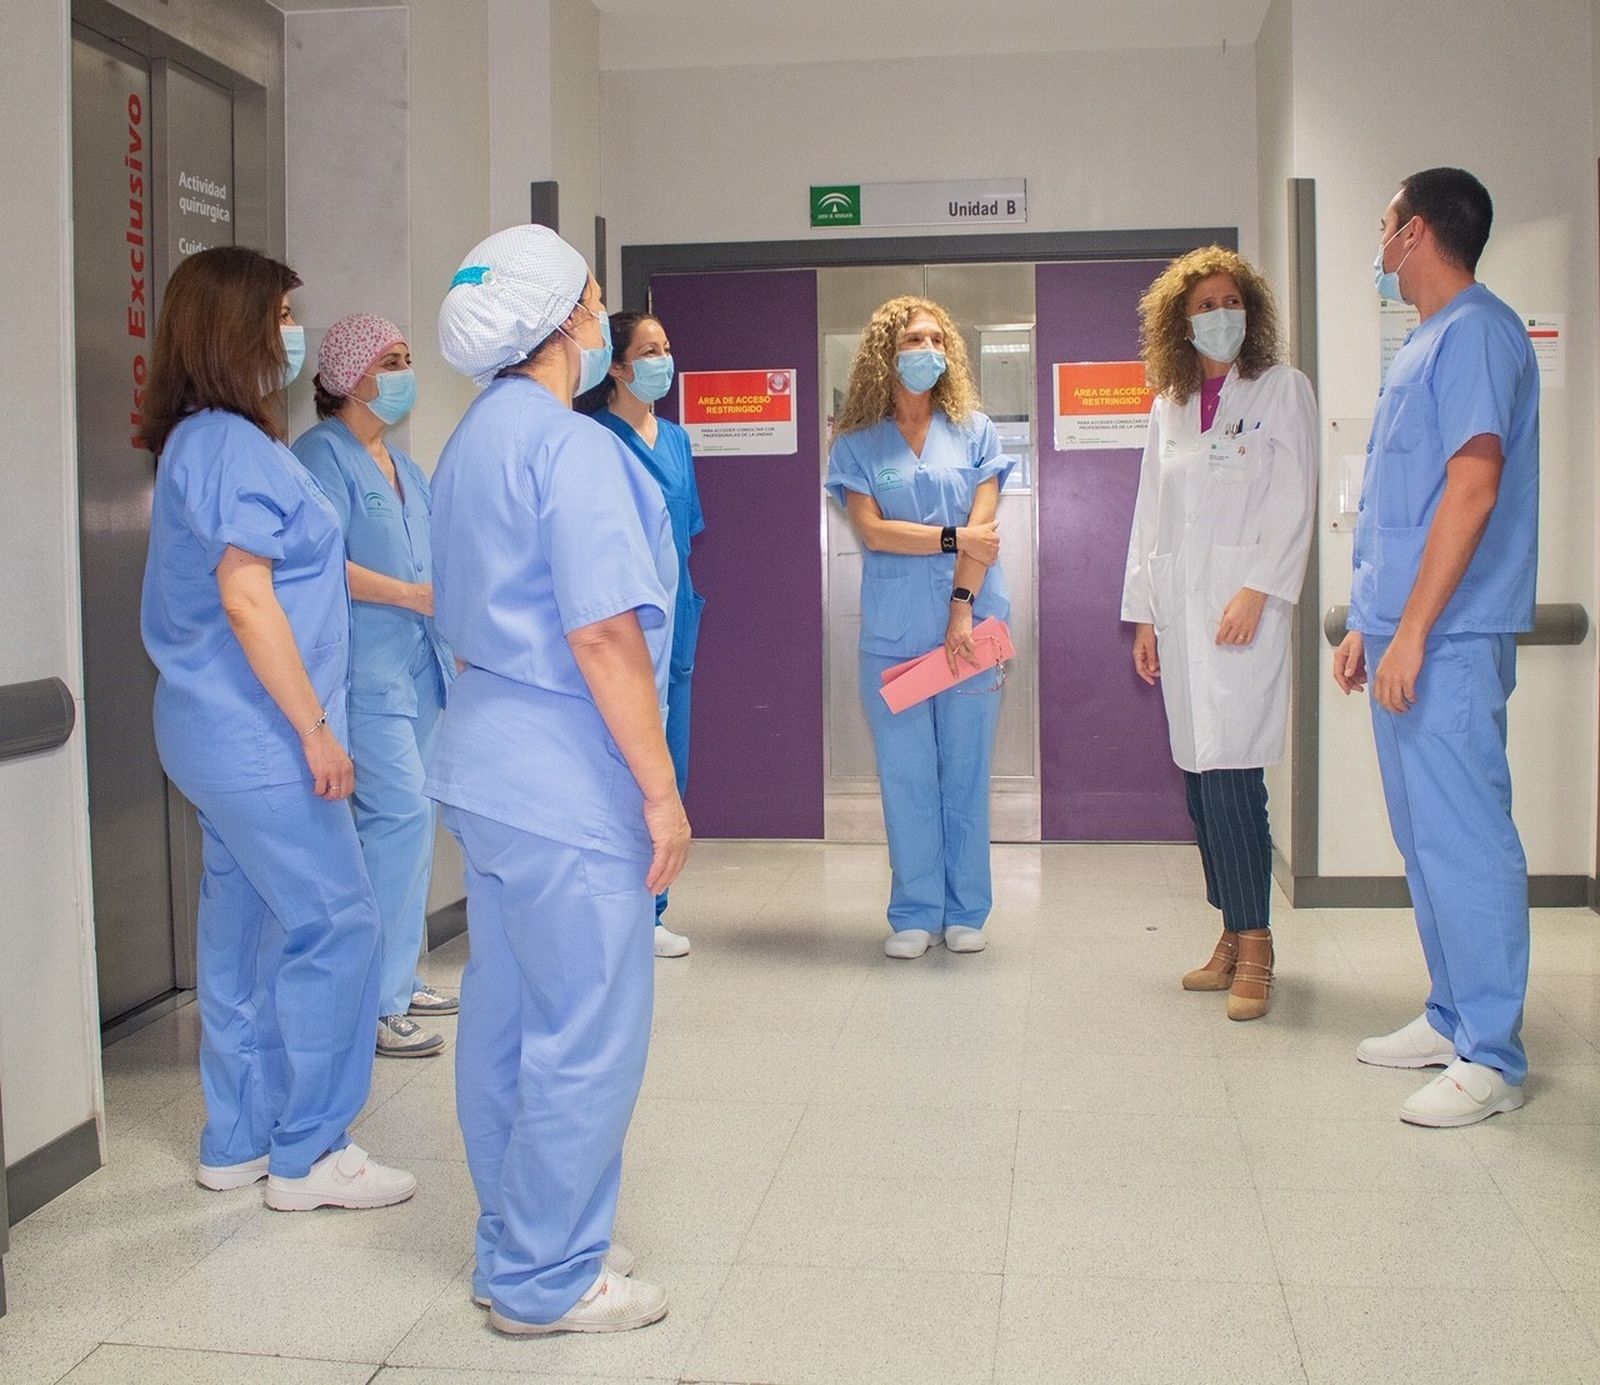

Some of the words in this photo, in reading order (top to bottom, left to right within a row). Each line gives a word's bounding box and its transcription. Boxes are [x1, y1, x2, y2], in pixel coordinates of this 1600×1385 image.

[178, 171, 226, 199] Actividad
[179, 196, 230, 223] quirúrgica
[949, 201, 999, 217] Unidad
[1007, 200, 1017, 215] B
[125, 94, 146, 339] Exclusivo
[1073, 387, 1098, 397] ÁREA
[1099, 388, 1112, 396] DE
[1113, 387, 1150, 396] ACCESO
[698, 395, 721, 405] ÁREA
[722, 396, 734, 404] DE
[736, 395, 771, 404] ACCESO
[1082, 397, 1141, 406] RESTRINGIDO
[706, 405, 763, 414] RESTRINGIDO
